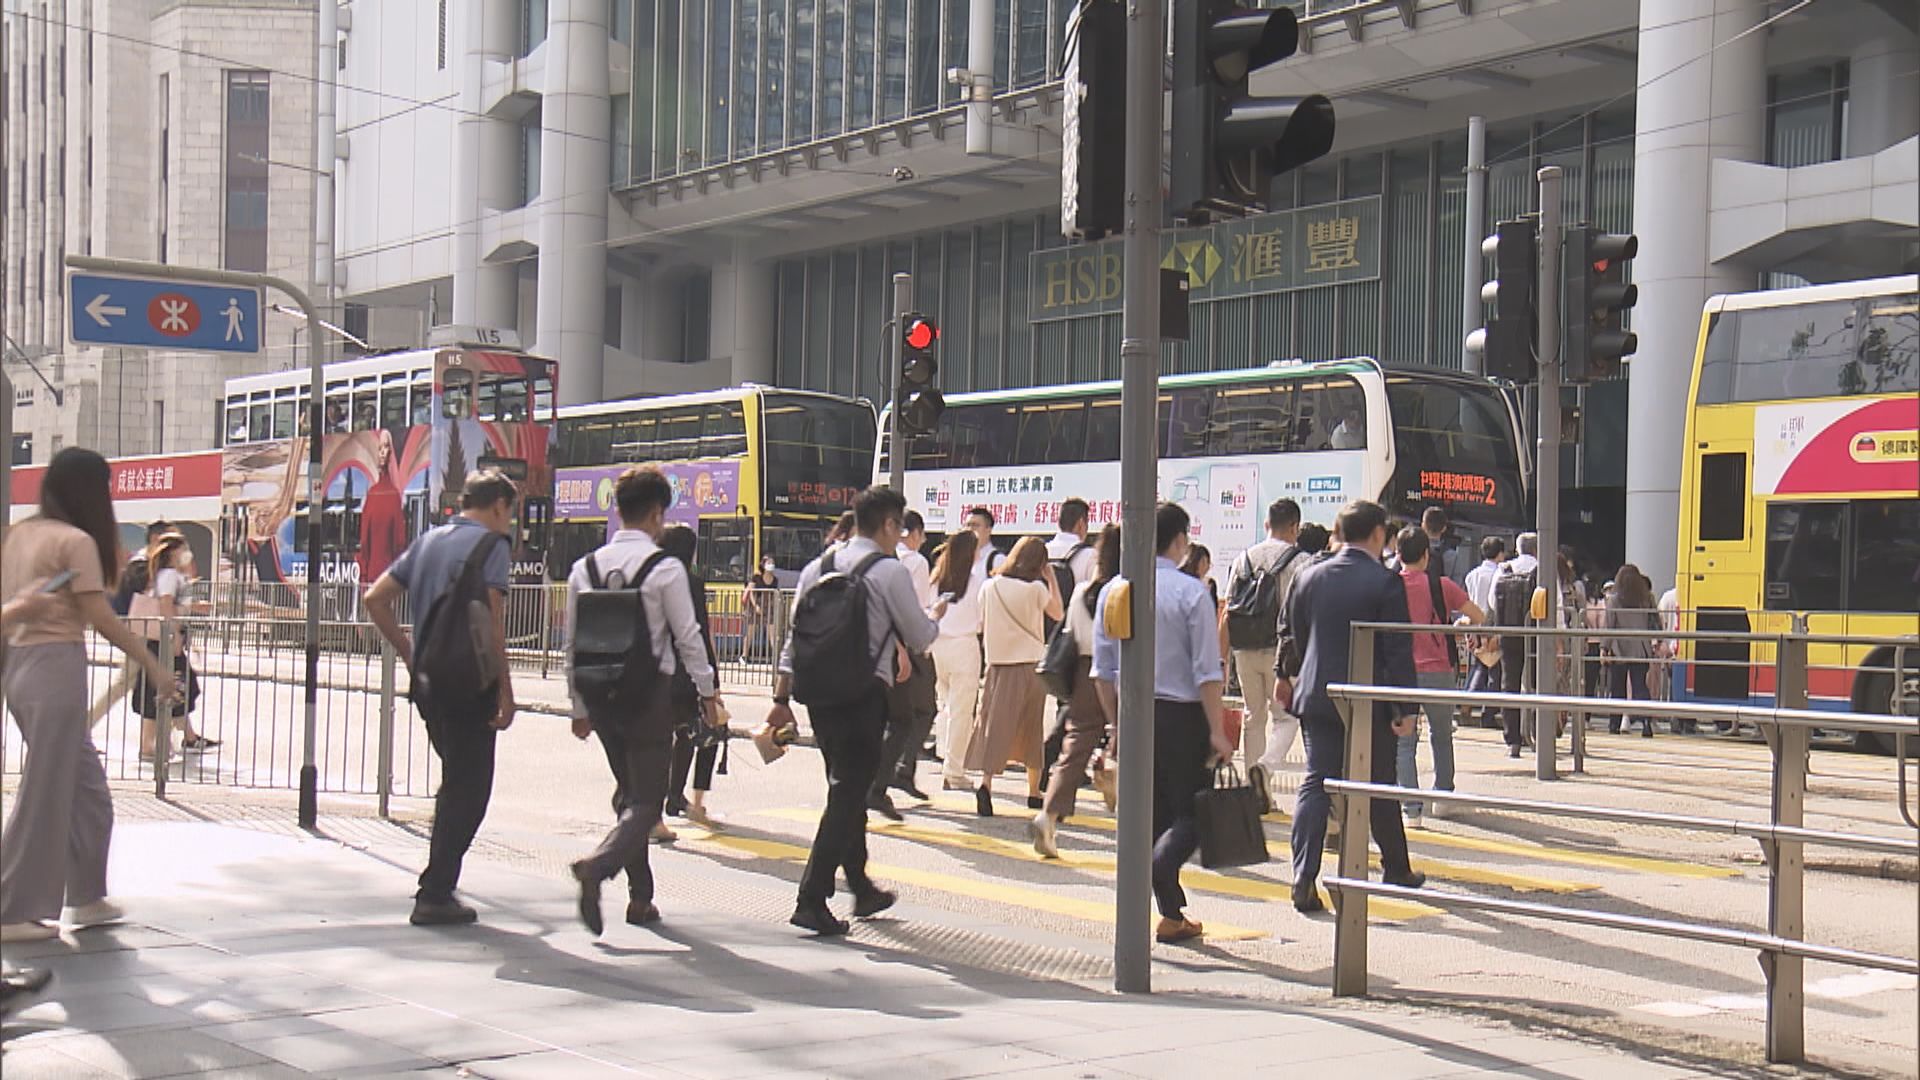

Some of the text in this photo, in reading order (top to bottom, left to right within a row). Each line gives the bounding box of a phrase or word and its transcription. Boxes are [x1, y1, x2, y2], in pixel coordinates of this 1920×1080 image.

[1043, 253, 1123, 308] HSB
[476, 328, 502, 344] 115
[448, 354, 462, 366] 115
[1485, 478, 1497, 505] 2
[292, 561, 361, 583] FEAGAMO
